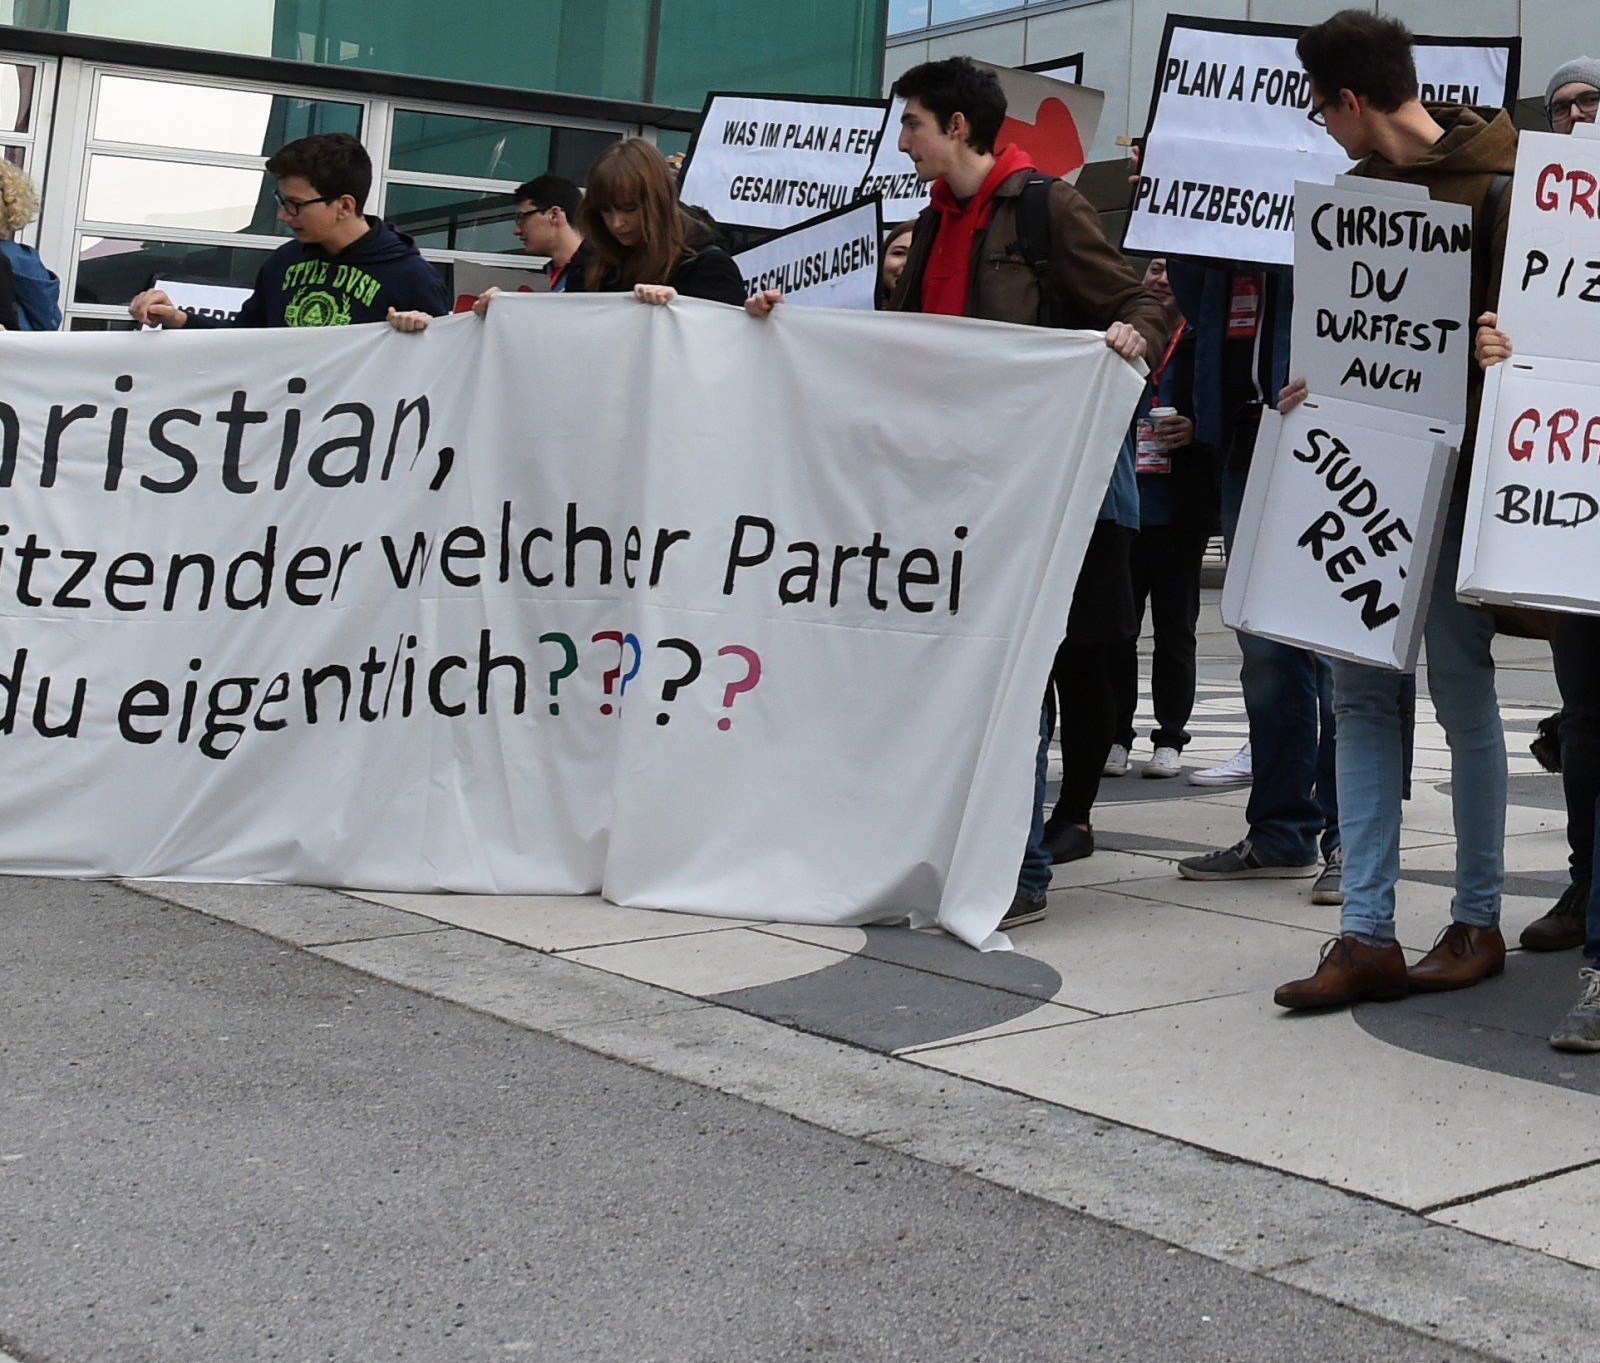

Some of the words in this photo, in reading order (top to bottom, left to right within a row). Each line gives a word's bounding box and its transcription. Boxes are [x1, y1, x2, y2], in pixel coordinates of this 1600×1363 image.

[1163, 58, 1227, 100] PLAN
[1228, 65, 1246, 102] A
[723, 120, 758, 146] WAS
[760, 122, 783, 148] IM
[783, 124, 823, 151] PLAN
[828, 127, 841, 152] A
[1311, 202, 1472, 253] CHRISTIAN
[282, 259, 330, 291] STYLE
[332, 265, 381, 307] DVSN
[1351, 261, 1408, 303] DU
[1316, 308, 1462, 354] DURFTEST
[1340, 357, 1422, 394] AUCH
[380, 500, 690, 590] welcher
[722, 514, 969, 616] Partei
[1297, 510, 1402, 631] REN
